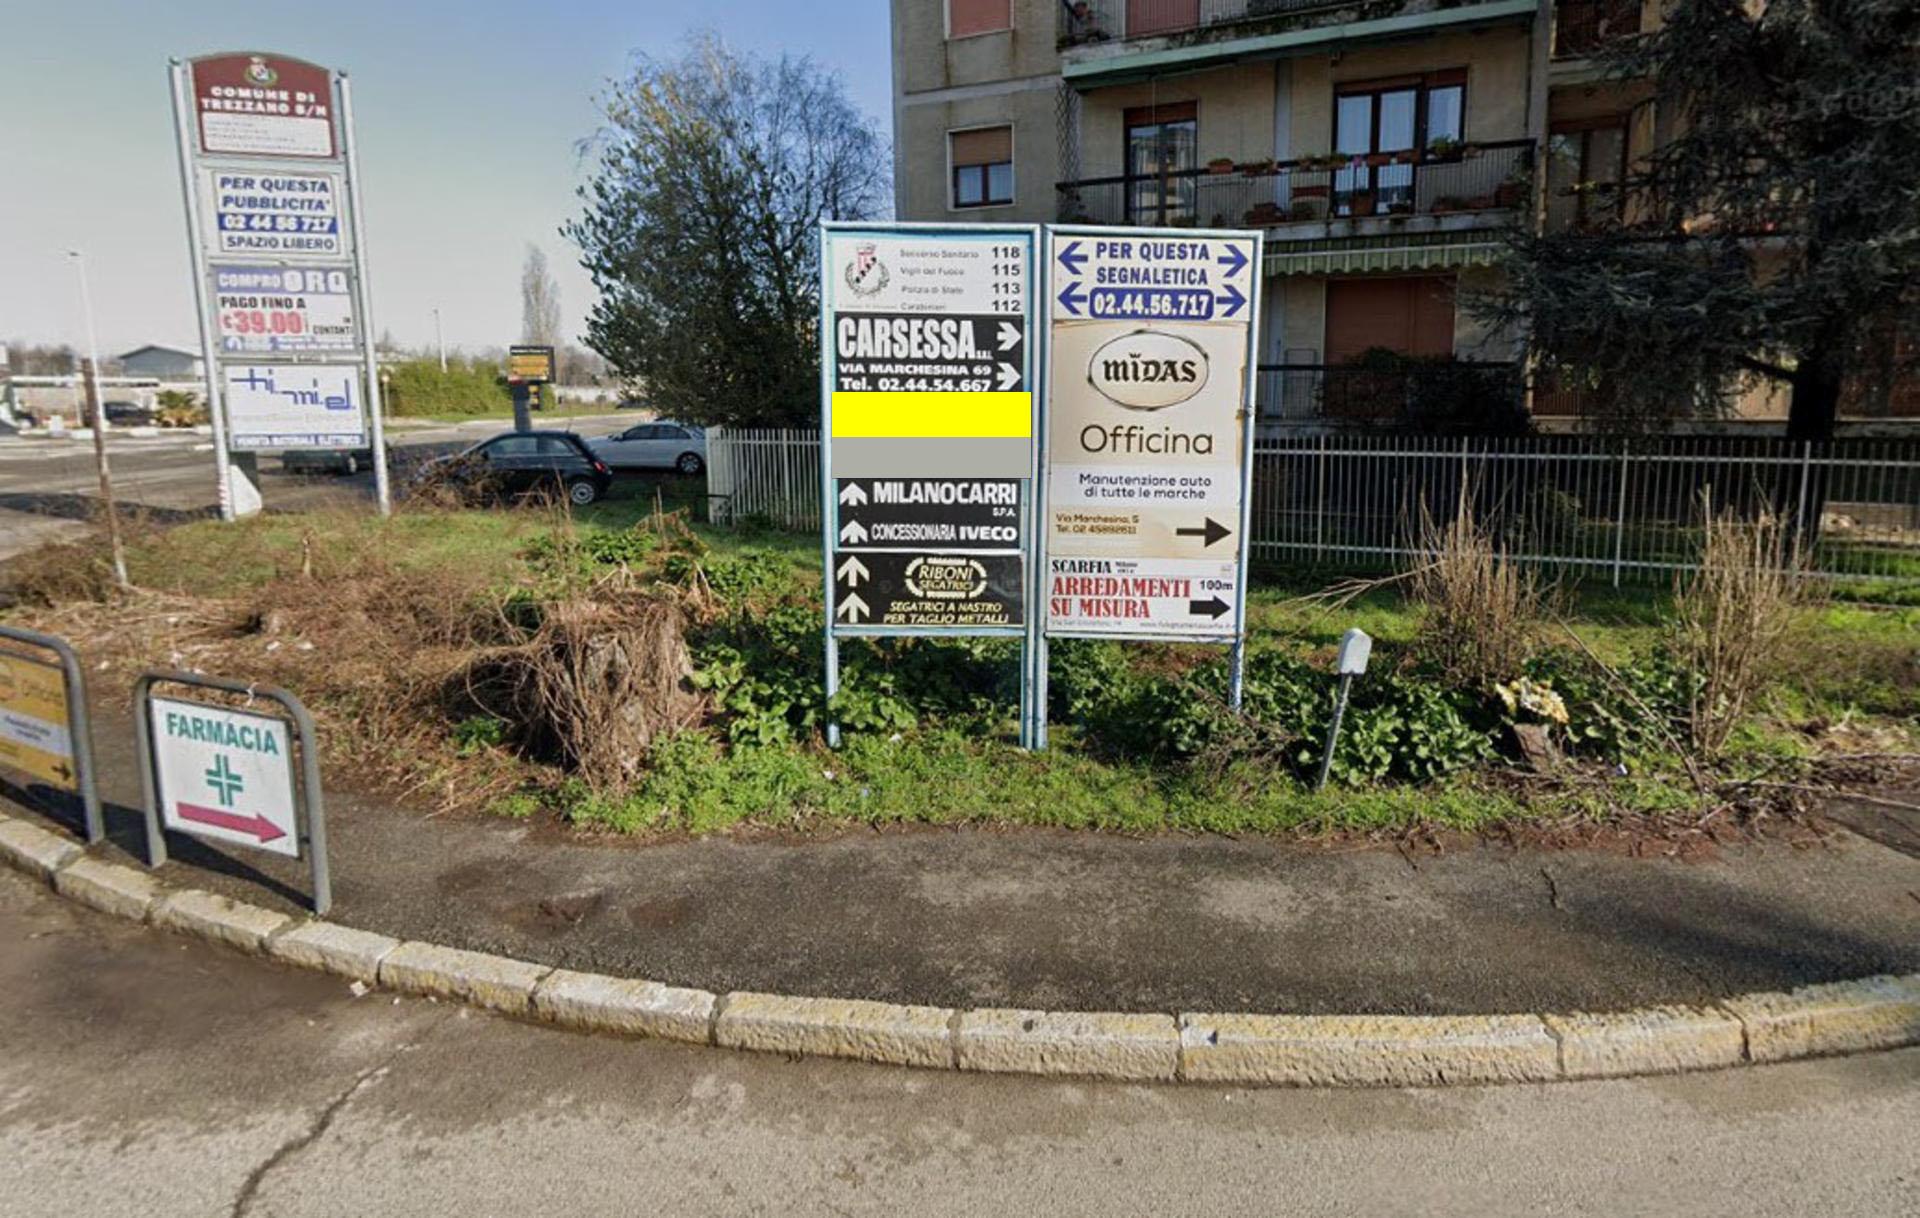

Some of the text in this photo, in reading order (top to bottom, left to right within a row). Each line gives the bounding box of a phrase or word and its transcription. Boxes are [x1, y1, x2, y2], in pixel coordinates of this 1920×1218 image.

[211, 86, 316, 102] COMUNE DI
[201, 98, 327, 117] TREZZANO S/N
[220, 177, 329, 193] PER QUESTA
[227, 236, 335, 250] SPAZIO LIBERO
[992, 246, 1021, 259] 118
[1096, 242, 1210, 261] PER QUESTA
[992, 264, 1021, 277] 115
[1096, 267, 1209, 285] SEGNALETICA
[992, 283, 1021, 295] 113
[221, 296, 306, 309] PAGO FINO A
[992, 300, 1021, 312] 112
[1093, 292, 1210, 316] 02.44.56.717
[838, 316, 976, 360] CARSESSA
[839, 363, 992, 376] VIA MARCHESINA 69
[840, 377, 992, 392] Tel. 02.44.54.667
[1081, 424, 1213, 454] Officina
[1079, 474, 1212, 487] Manutenzione auto
[873, 482, 1017, 504] MILANOCARRI
[1084, 487, 1206, 499] di tutte le marche
[871, 523, 1017, 541] CONCESSIONARIA IVECO
[919, 565, 973, 581] RIBONI
[1052, 560, 1112, 574] SCARFIA
[919, 580, 974, 591] SEGATRICI
[1052, 576, 1233, 598] ARREDAMENTI 100m
[890, 602, 1002, 613] SEGATRICI A NASTRO
[1051, 598, 1150, 618] SU MISURA
[883, 613, 1009, 624] PER TAGLIO METALLI
[166, 712, 280, 755] FARMACIA
